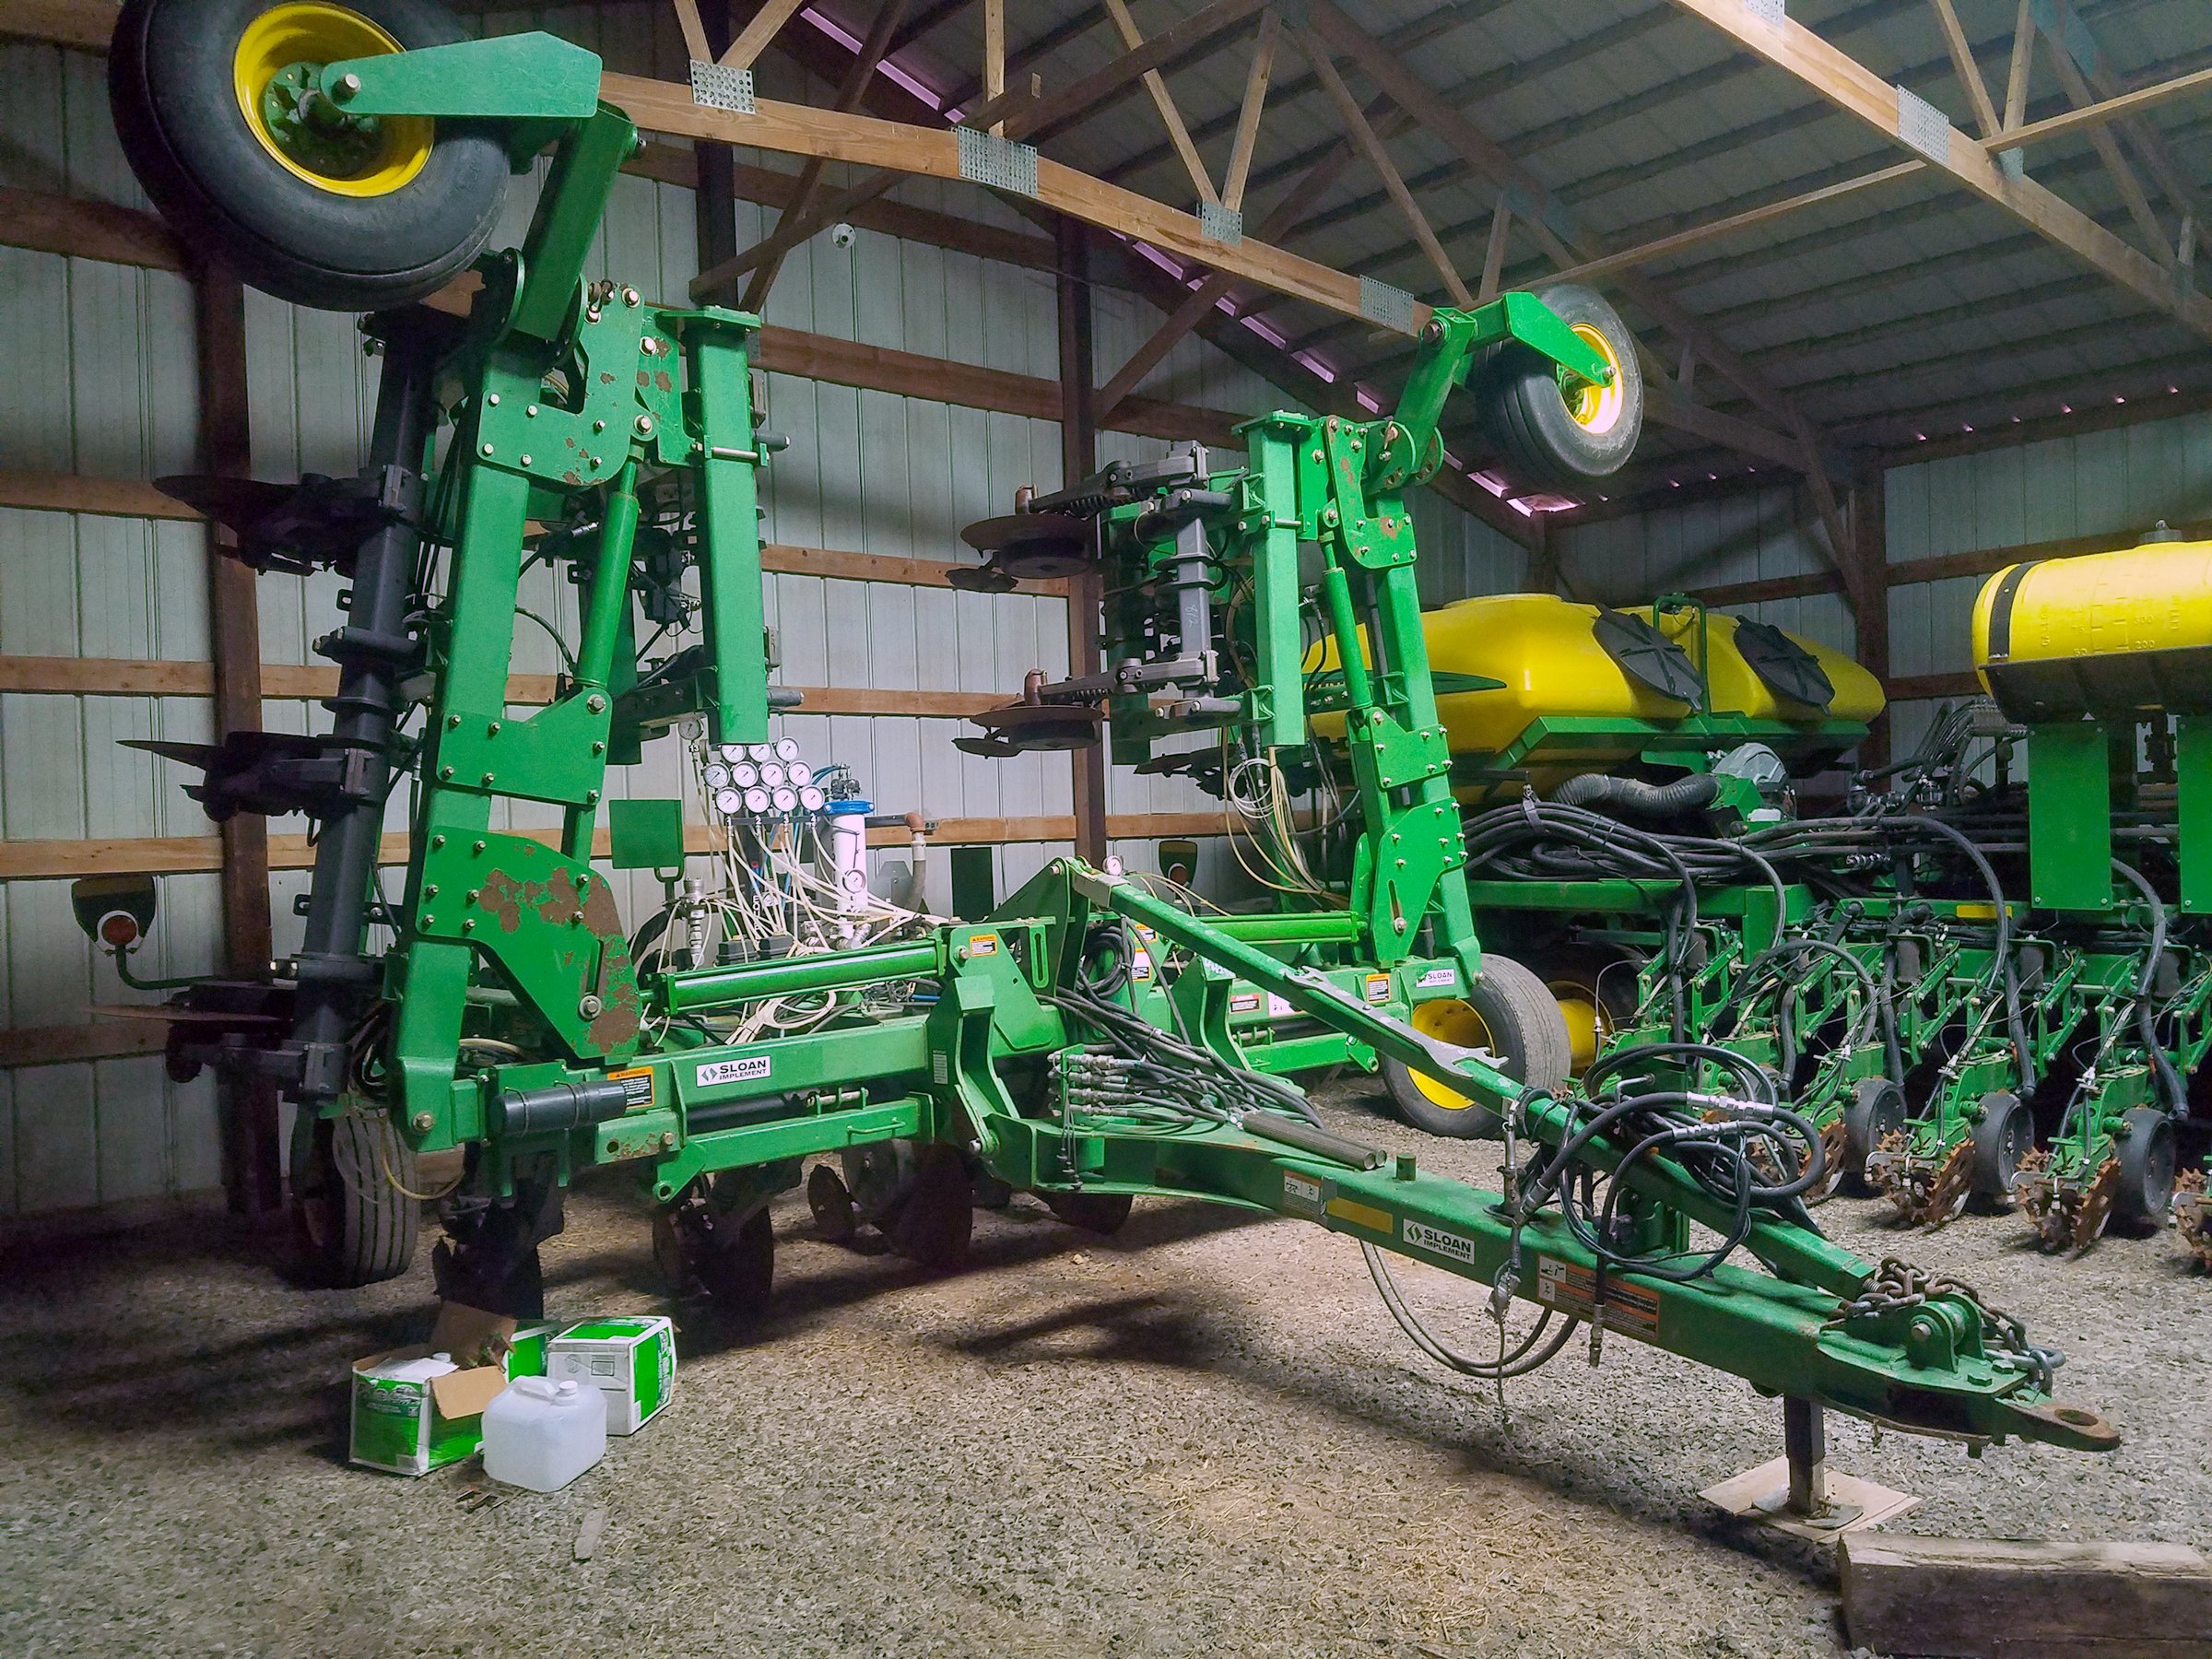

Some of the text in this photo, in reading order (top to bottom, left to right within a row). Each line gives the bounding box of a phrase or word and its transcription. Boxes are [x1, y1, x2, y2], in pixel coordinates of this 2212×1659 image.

[719, 1069, 767, 1080] IMPLEMENT
[720, 1059, 766, 1074] SLOAN
[1424, 1229, 1471, 1253] SLOAN
[1423, 1240, 1471, 1260] IMPLEMENT
